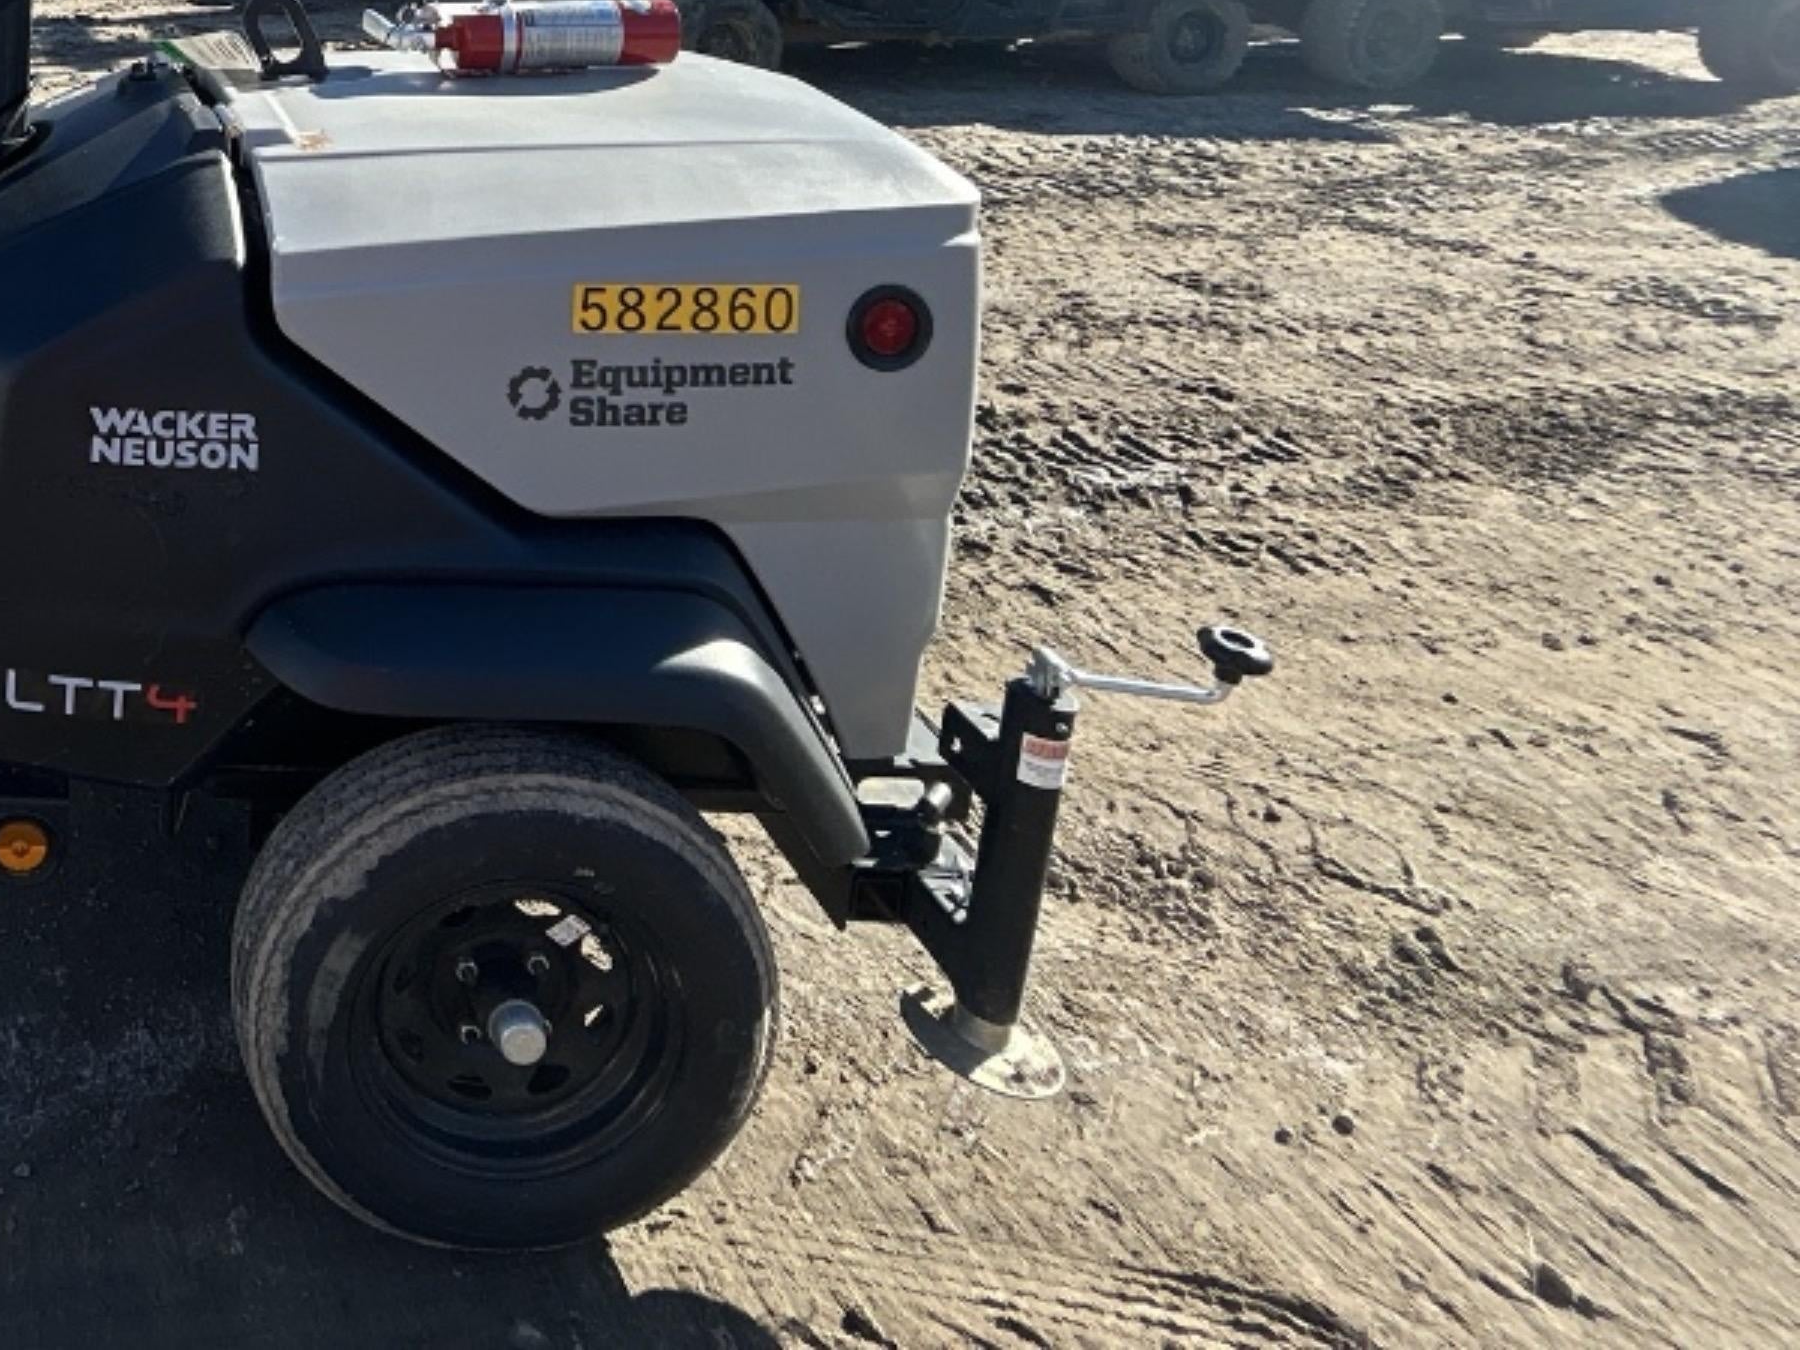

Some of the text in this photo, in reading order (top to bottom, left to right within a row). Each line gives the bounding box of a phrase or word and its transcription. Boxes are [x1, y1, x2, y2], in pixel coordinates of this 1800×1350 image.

[579, 286, 795, 332] 582860
[569, 357, 795, 396] Equipment
[89, 407, 259, 441] WACKER
[569, 396, 688, 427] Share
[89, 436, 259, 471] NEUSON
[5, 668, 197, 724] LTT4
